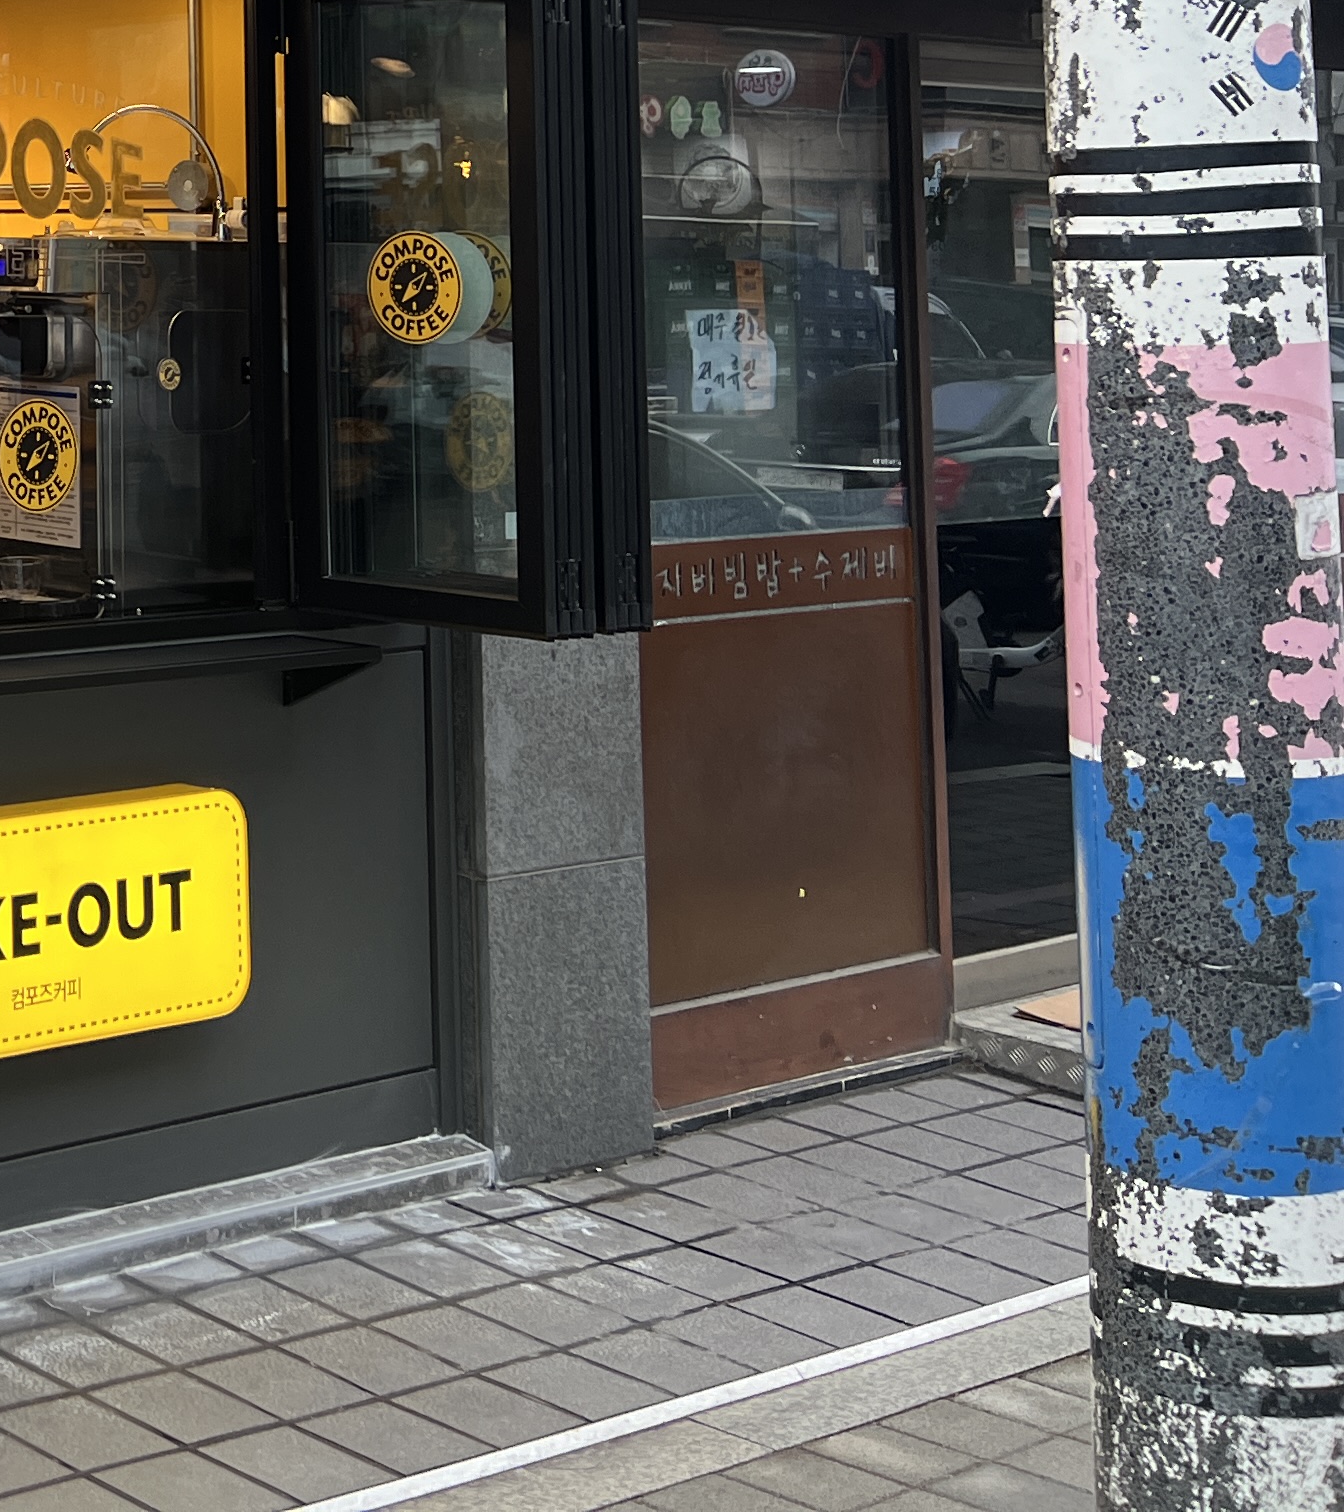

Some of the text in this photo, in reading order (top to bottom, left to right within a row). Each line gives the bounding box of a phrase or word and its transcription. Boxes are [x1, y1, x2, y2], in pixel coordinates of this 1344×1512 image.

[375, 237, 455, 283] COMPOSE
[381, 302, 450, 338] COFFEE
[697, 312, 728, 343] 매주
[697, 353, 758, 396] 정기휴일
[4, 406, 73, 453] COMPOSE
[7, 472, 66, 506] COFFEE
[10, 976, 83, 1011] 컴포즈커피
